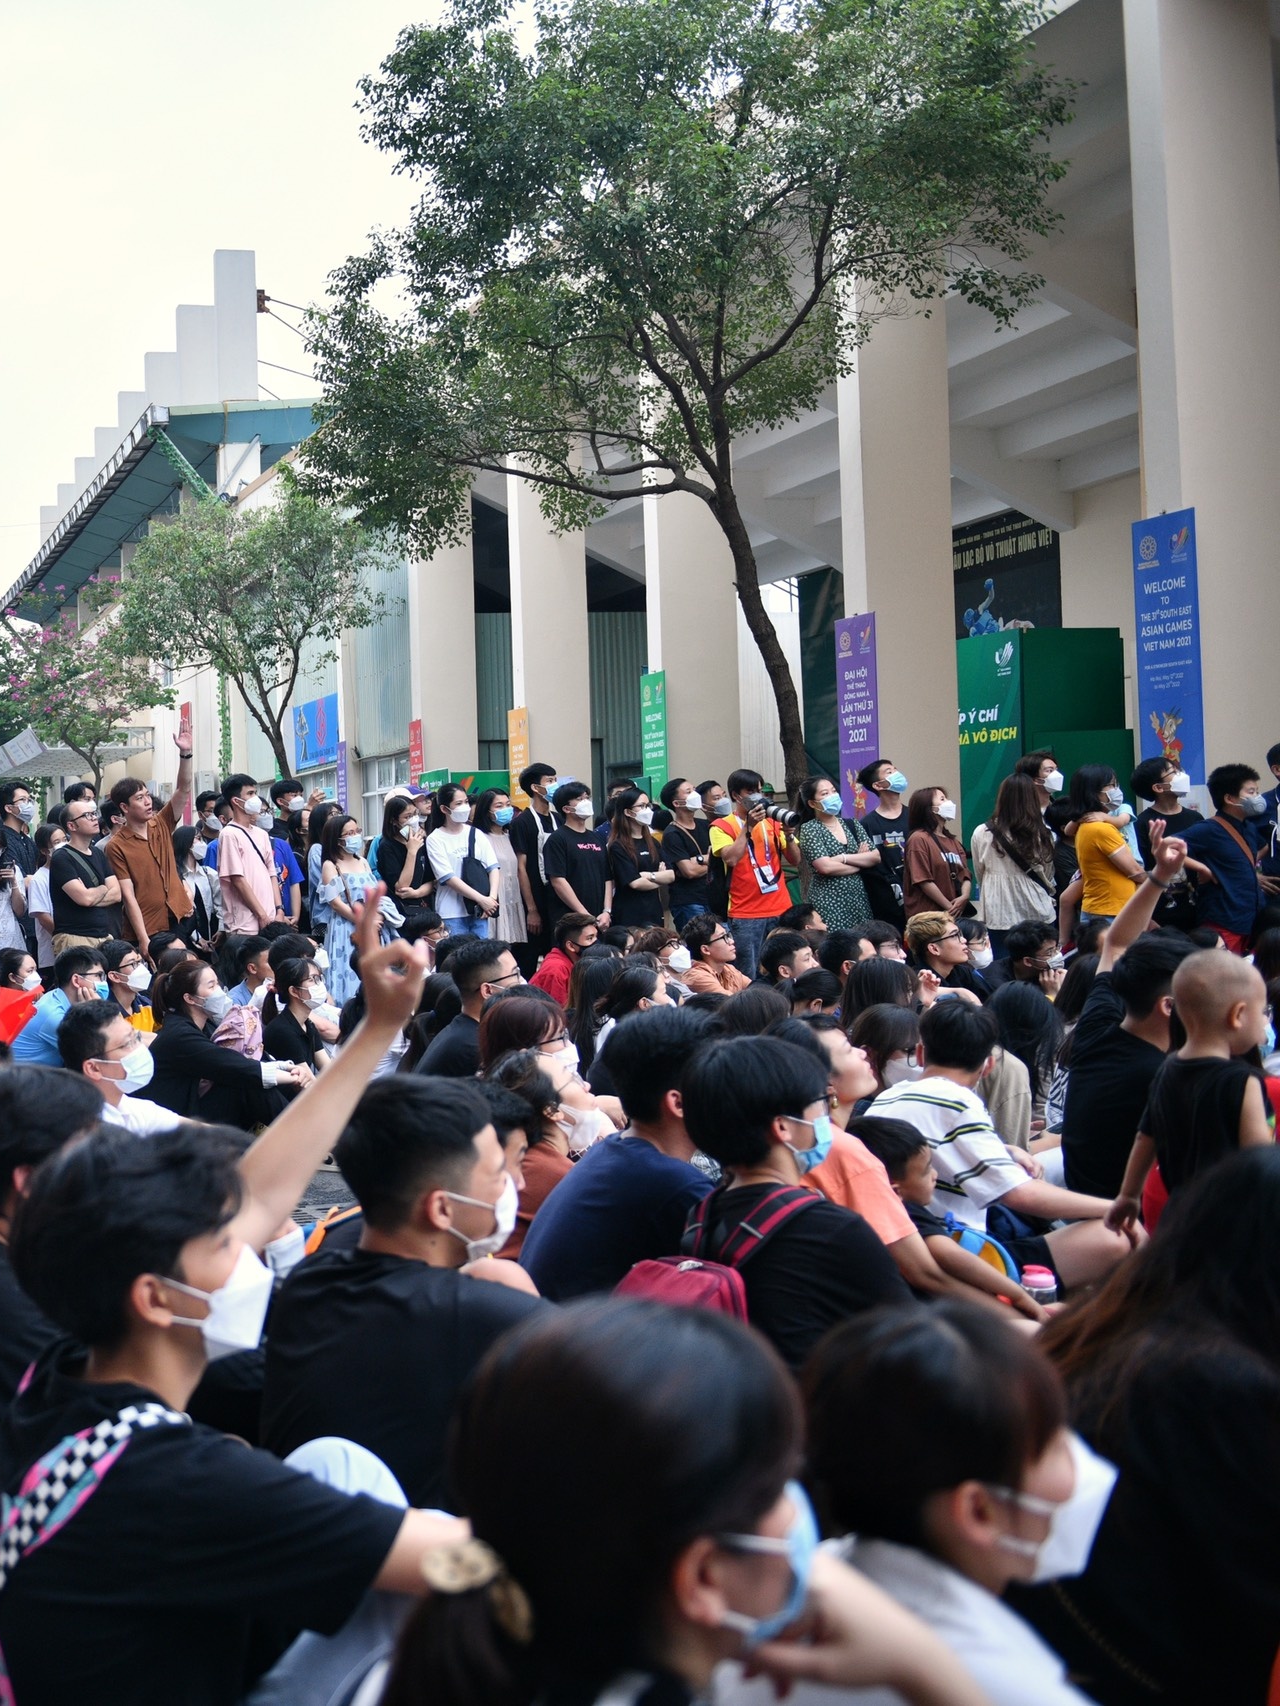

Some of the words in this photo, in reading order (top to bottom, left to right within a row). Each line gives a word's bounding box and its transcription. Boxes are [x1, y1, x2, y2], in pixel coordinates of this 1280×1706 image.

[953, 552, 961, 571] ÂU
[1144, 576, 1186, 594] WELCOME
[1161, 596, 1169, 605] TO
[1141, 613, 1151, 622] THE
[1160, 608, 1178, 619] SOUTH
[1179, 606, 1192, 616] EAST
[1141, 624, 1164, 637] ASIAN
[1165, 619, 1192, 633] GAMES
[1144, 641, 1158, 652] VIET
[1160, 639, 1175, 649] NAM
[1177, 636, 1191, 647] 2021
[845, 670, 855, 681] ĐẠI
[856, 666, 867, 679] HỘI
[868, 701, 873, 710] 31
[843, 714, 856, 728] VIỆT
[857, 714, 871, 724] NAM
[958, 709, 966, 725] P
[968, 708, 976, 724] Ý
[978, 704, 999, 723] CHÍ
[849, 728, 867, 743] 2021
[972, 728, 987, 743] VÔ
[990, 727, 1017, 743] ĐỊCH
